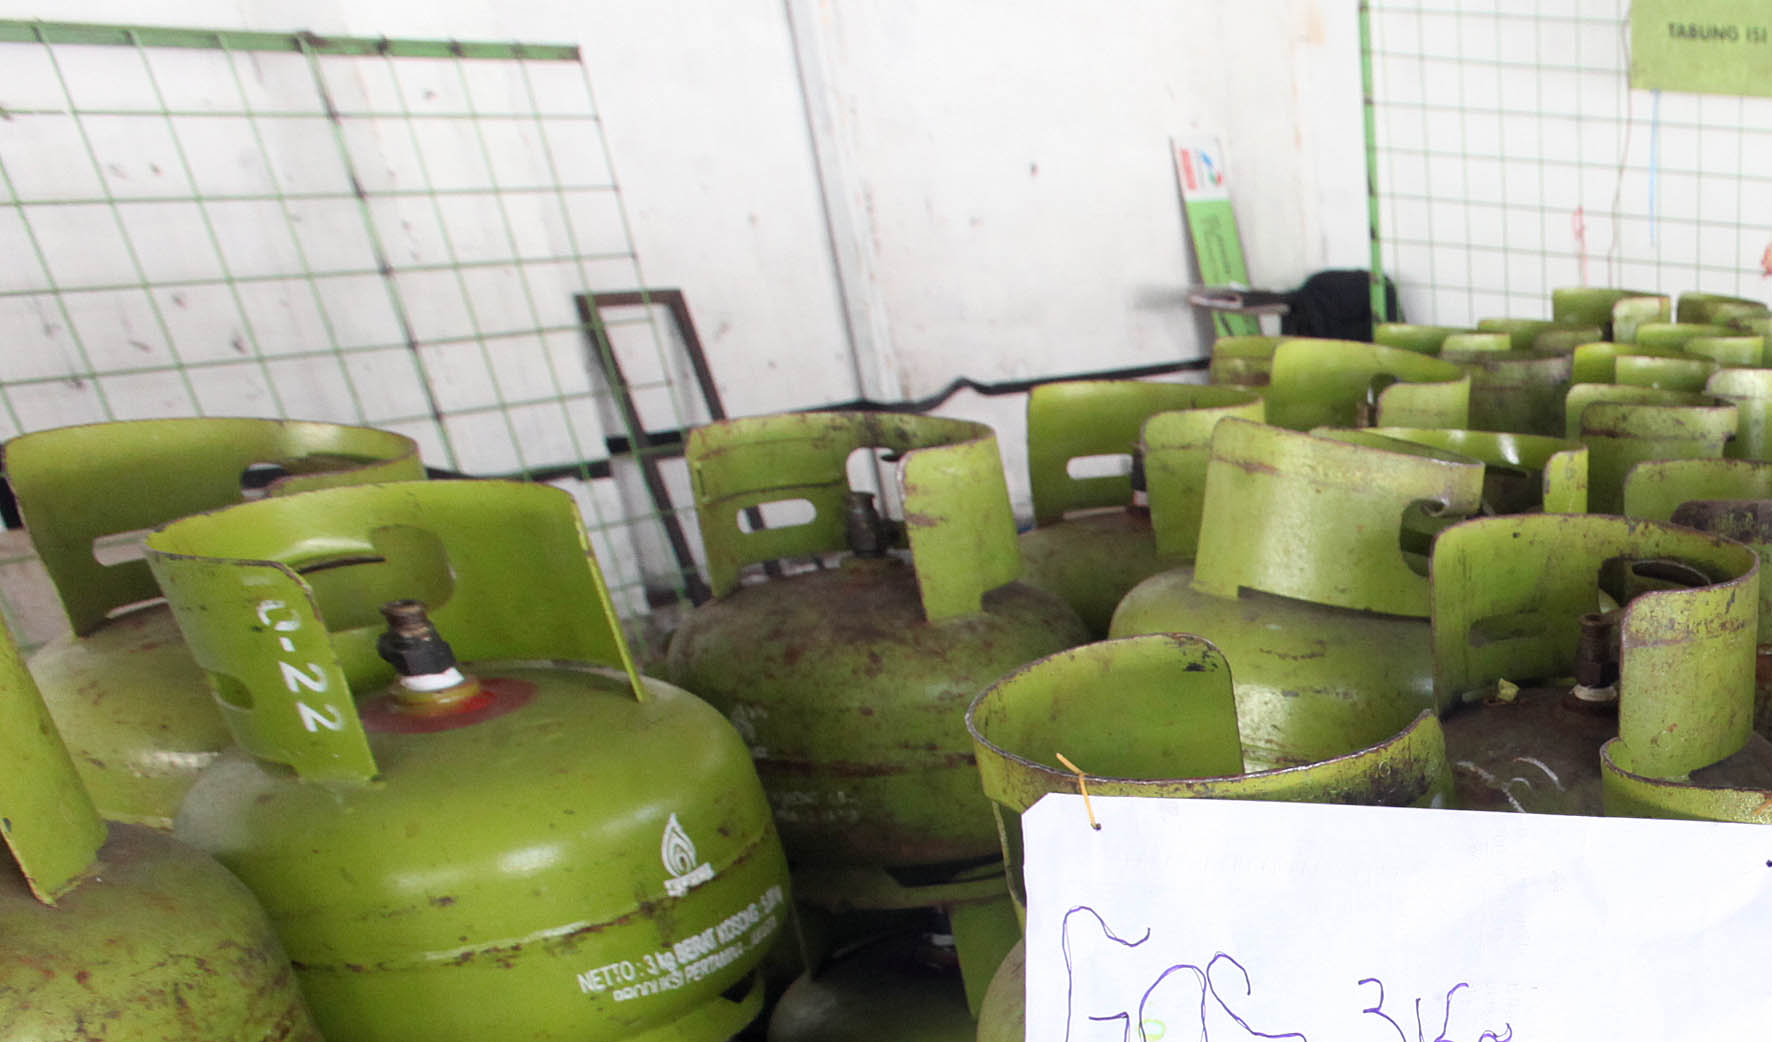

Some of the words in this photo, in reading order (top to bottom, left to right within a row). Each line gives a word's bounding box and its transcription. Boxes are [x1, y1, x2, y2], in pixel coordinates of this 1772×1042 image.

[1667, 22, 1740, 42] TABUNG
[1745, 25, 1768, 44] ISI
[577, 960, 635, 994] NETTO
[643, 954, 659, 976] 3
